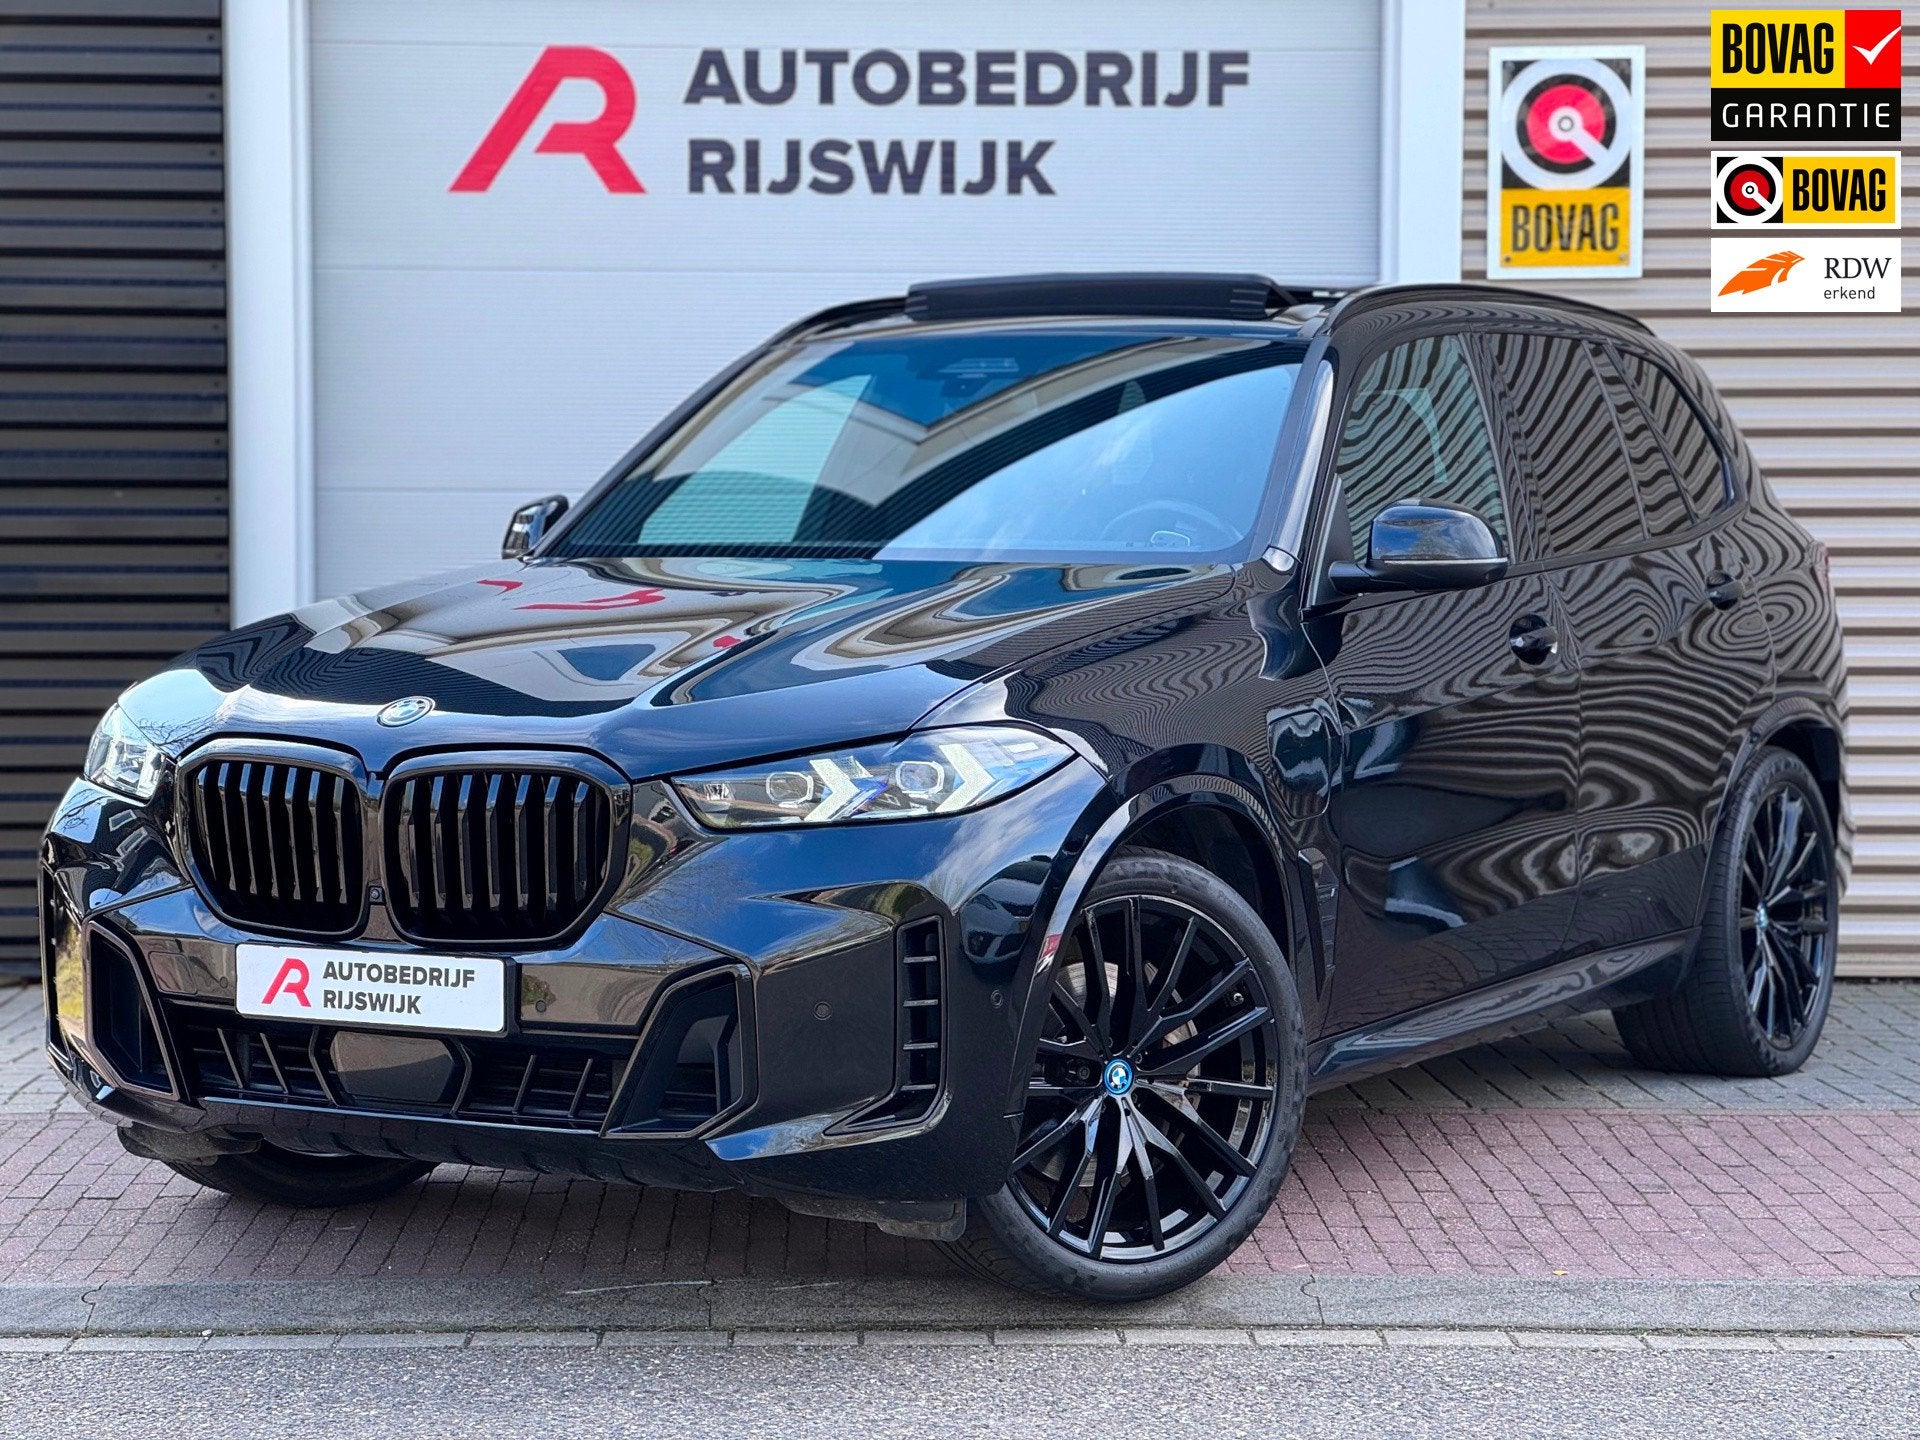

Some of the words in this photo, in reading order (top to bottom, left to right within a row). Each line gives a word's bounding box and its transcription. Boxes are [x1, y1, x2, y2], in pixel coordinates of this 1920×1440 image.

[683, 49, 1250, 107] AUTOBEDRIJF
[688, 139, 1057, 196] RIJSWIJK
[1511, 203, 1619, 253] BOVAG
[323, 961, 475, 988] AUTOBEDRIJF
[323, 990, 421, 1014] RIJSWIJK
